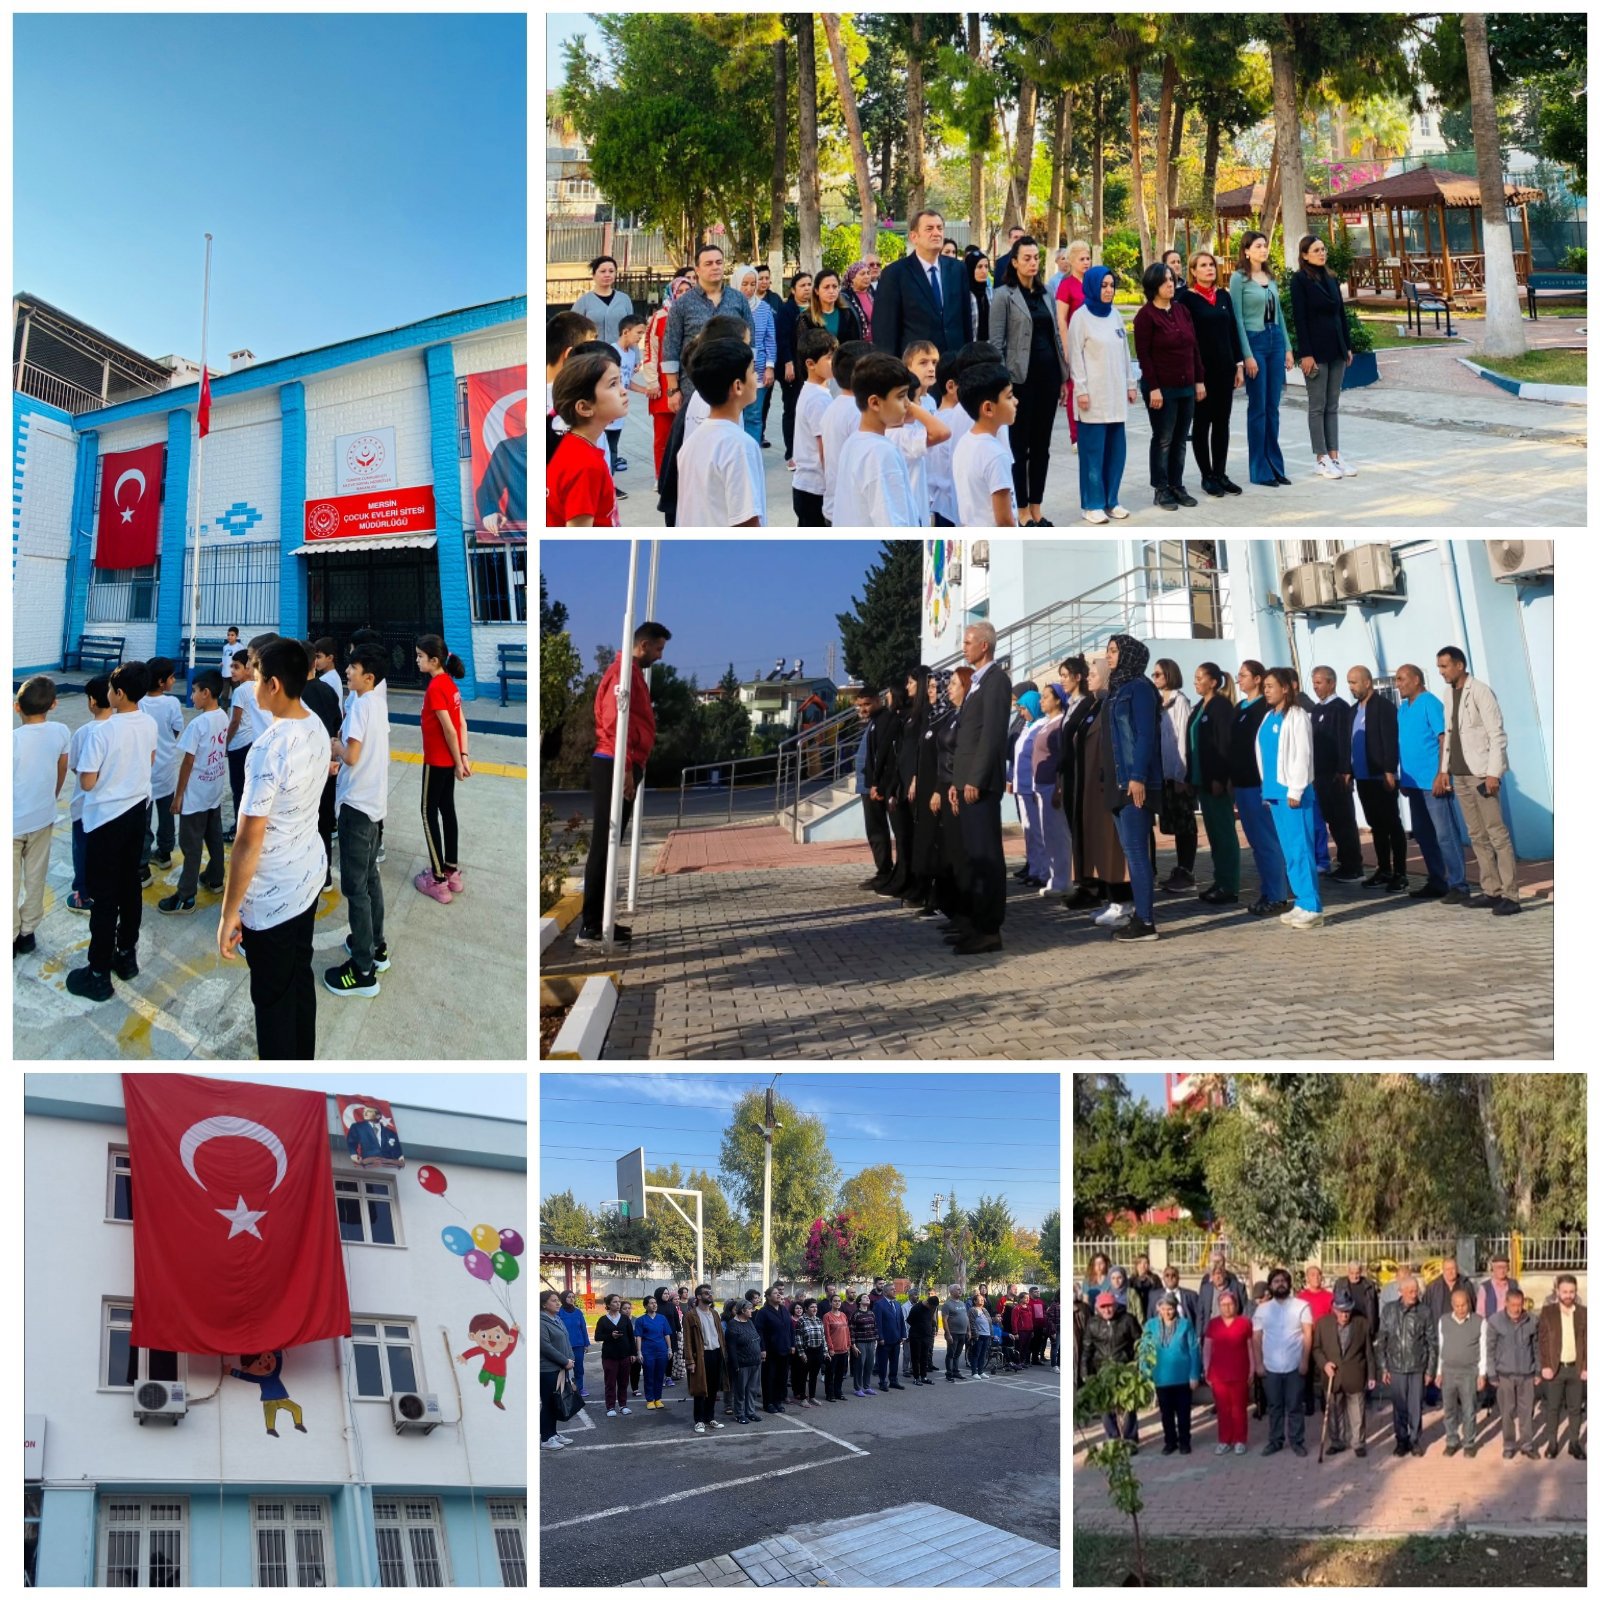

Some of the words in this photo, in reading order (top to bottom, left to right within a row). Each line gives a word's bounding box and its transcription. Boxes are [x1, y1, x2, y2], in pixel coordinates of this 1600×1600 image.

[368, 499, 397, 510] MERSİN
[343, 513, 370, 523] ÇOCUK
[371, 509, 398, 519] EVLERİ
[400, 505, 425, 515] SİTESİ
[359, 517, 409, 530] MÜDÜRLÜĞÜ
